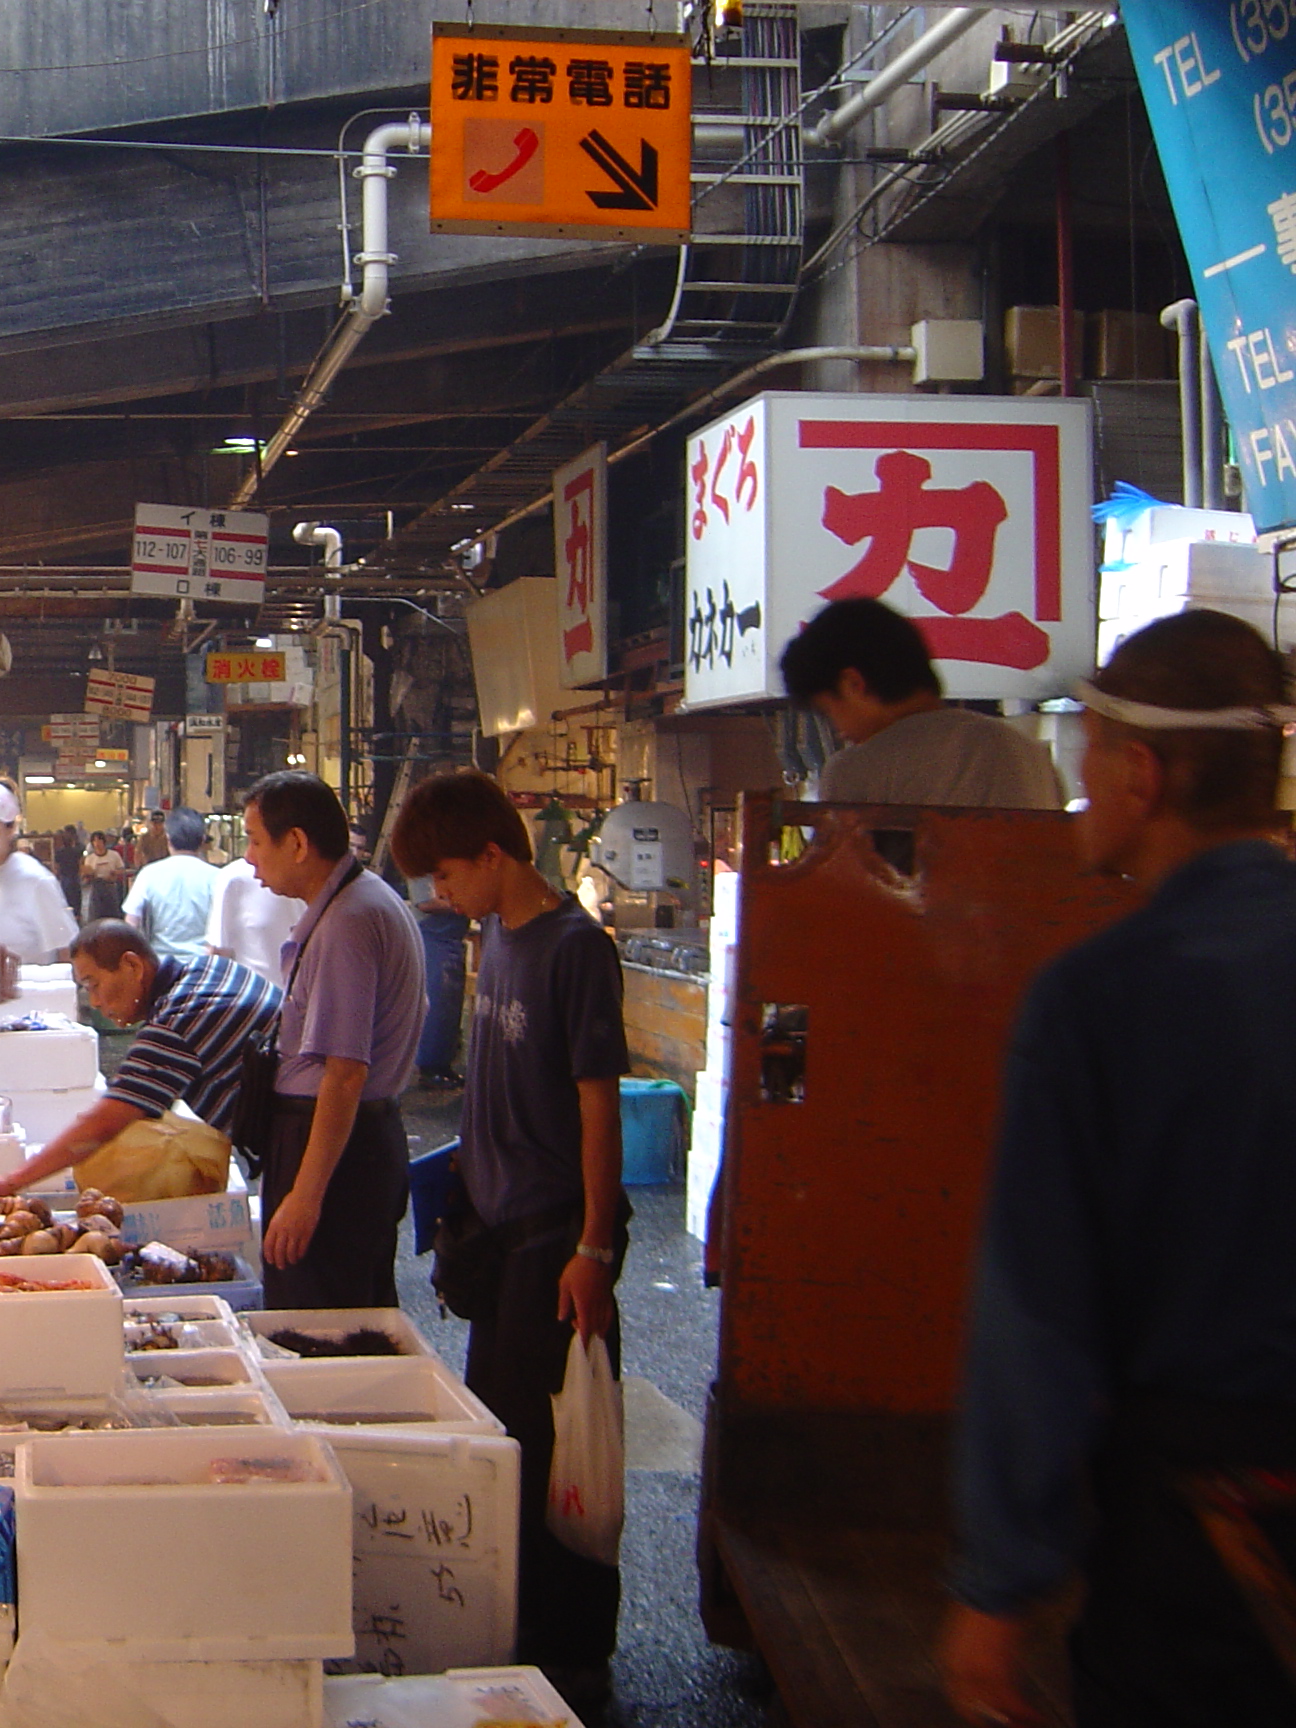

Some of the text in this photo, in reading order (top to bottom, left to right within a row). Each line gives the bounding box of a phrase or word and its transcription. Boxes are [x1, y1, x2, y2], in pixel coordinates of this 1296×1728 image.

[451, 53, 671, 110] 非常電話
[1153, 0, 1296, 106] TEL (35
[1227, 328, 1294, 394] TEL
[692, 415, 758, 541] まぐろ
[1250, 419, 1296, 487] FA
[213, 546, 263, 566] 106-99
[212, 658, 281, 679] 消火栓
